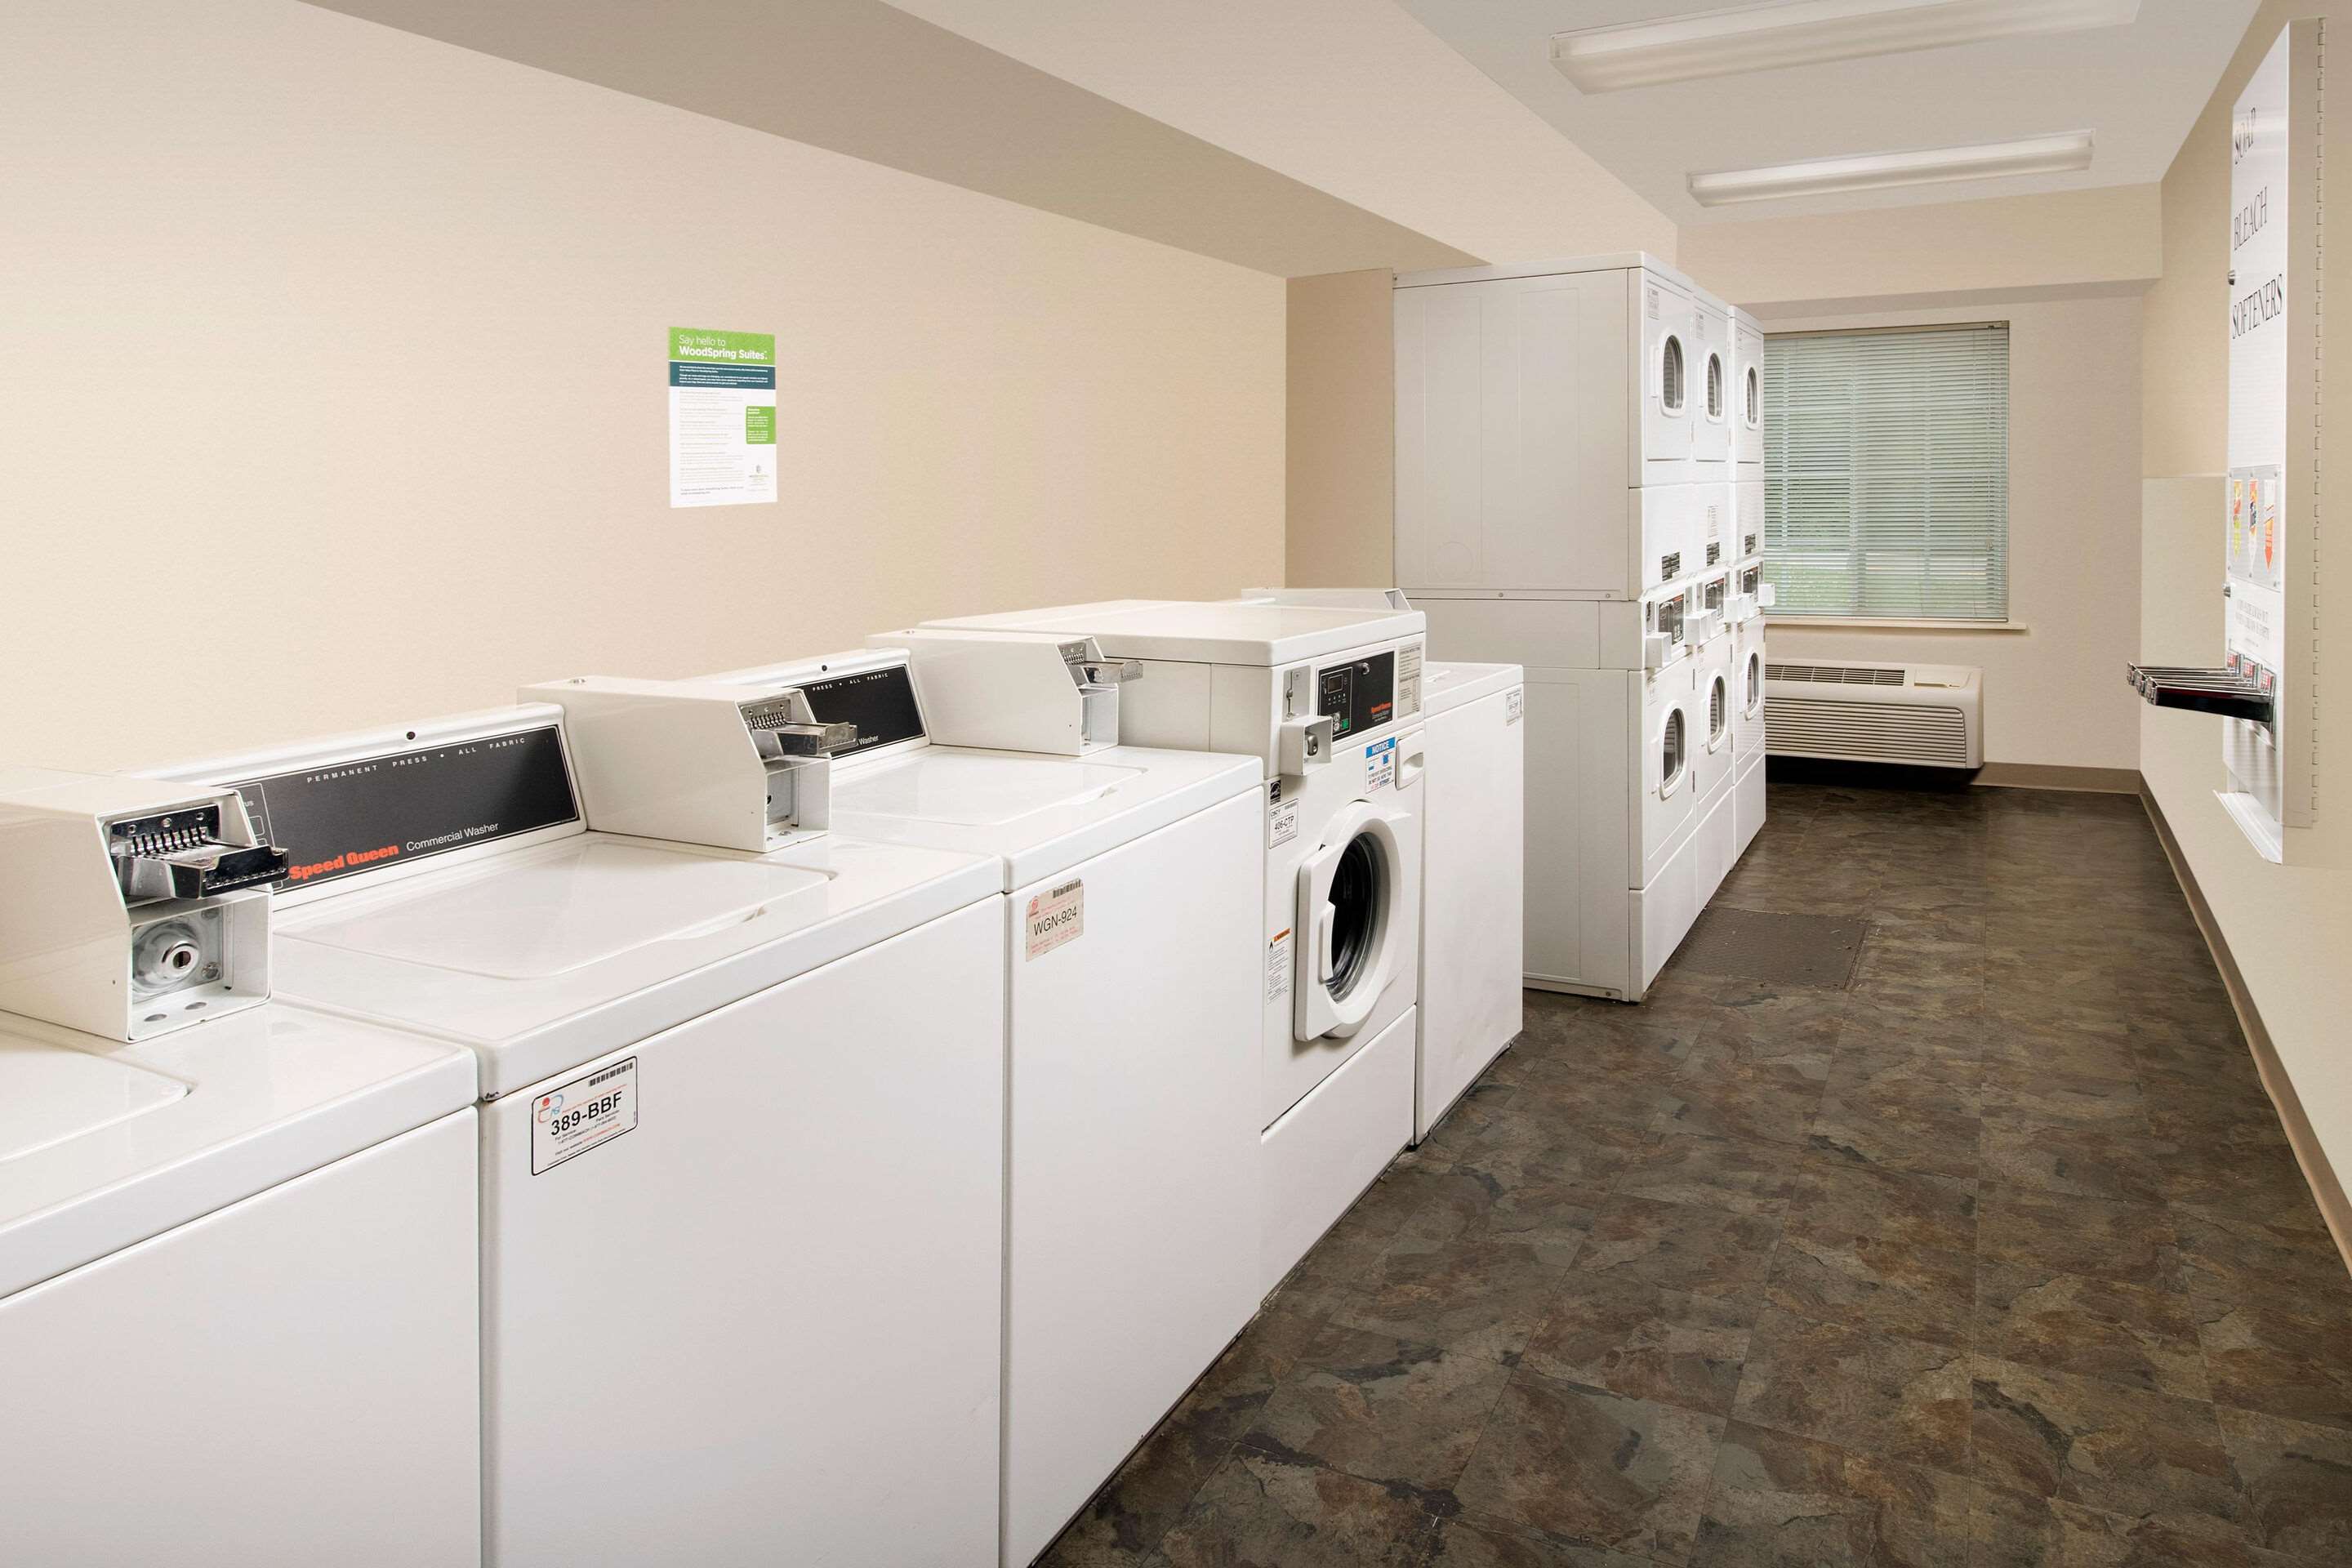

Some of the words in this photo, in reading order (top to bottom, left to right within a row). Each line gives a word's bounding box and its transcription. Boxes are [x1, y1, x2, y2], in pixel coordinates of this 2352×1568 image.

[2234, 185, 2268, 252] BLEACH
[2232, 273, 2283, 340] SOFTENERS
[679, 334, 693, 346] Say
[696, 336, 715, 346] hello
[717, 338, 726, 346] to
[679, 345, 737, 359] WoodSpring
[306, 764, 379, 784] PERMANENT
[392, 755, 428, 768] PRESS
[458, 746, 477, 755] ALL
[489, 737, 526, 750] FABRIC
[859, 736, 879, 745] Washer
[288, 855, 345, 881] Speed
[346, 844, 399, 866] Queen
[406, 830, 463, 852] Commercial
[463, 822, 500, 838] Washer
[1033, 906, 1077, 937] WGN-924
[551, 1090, 622, 1136] 389-BBF
